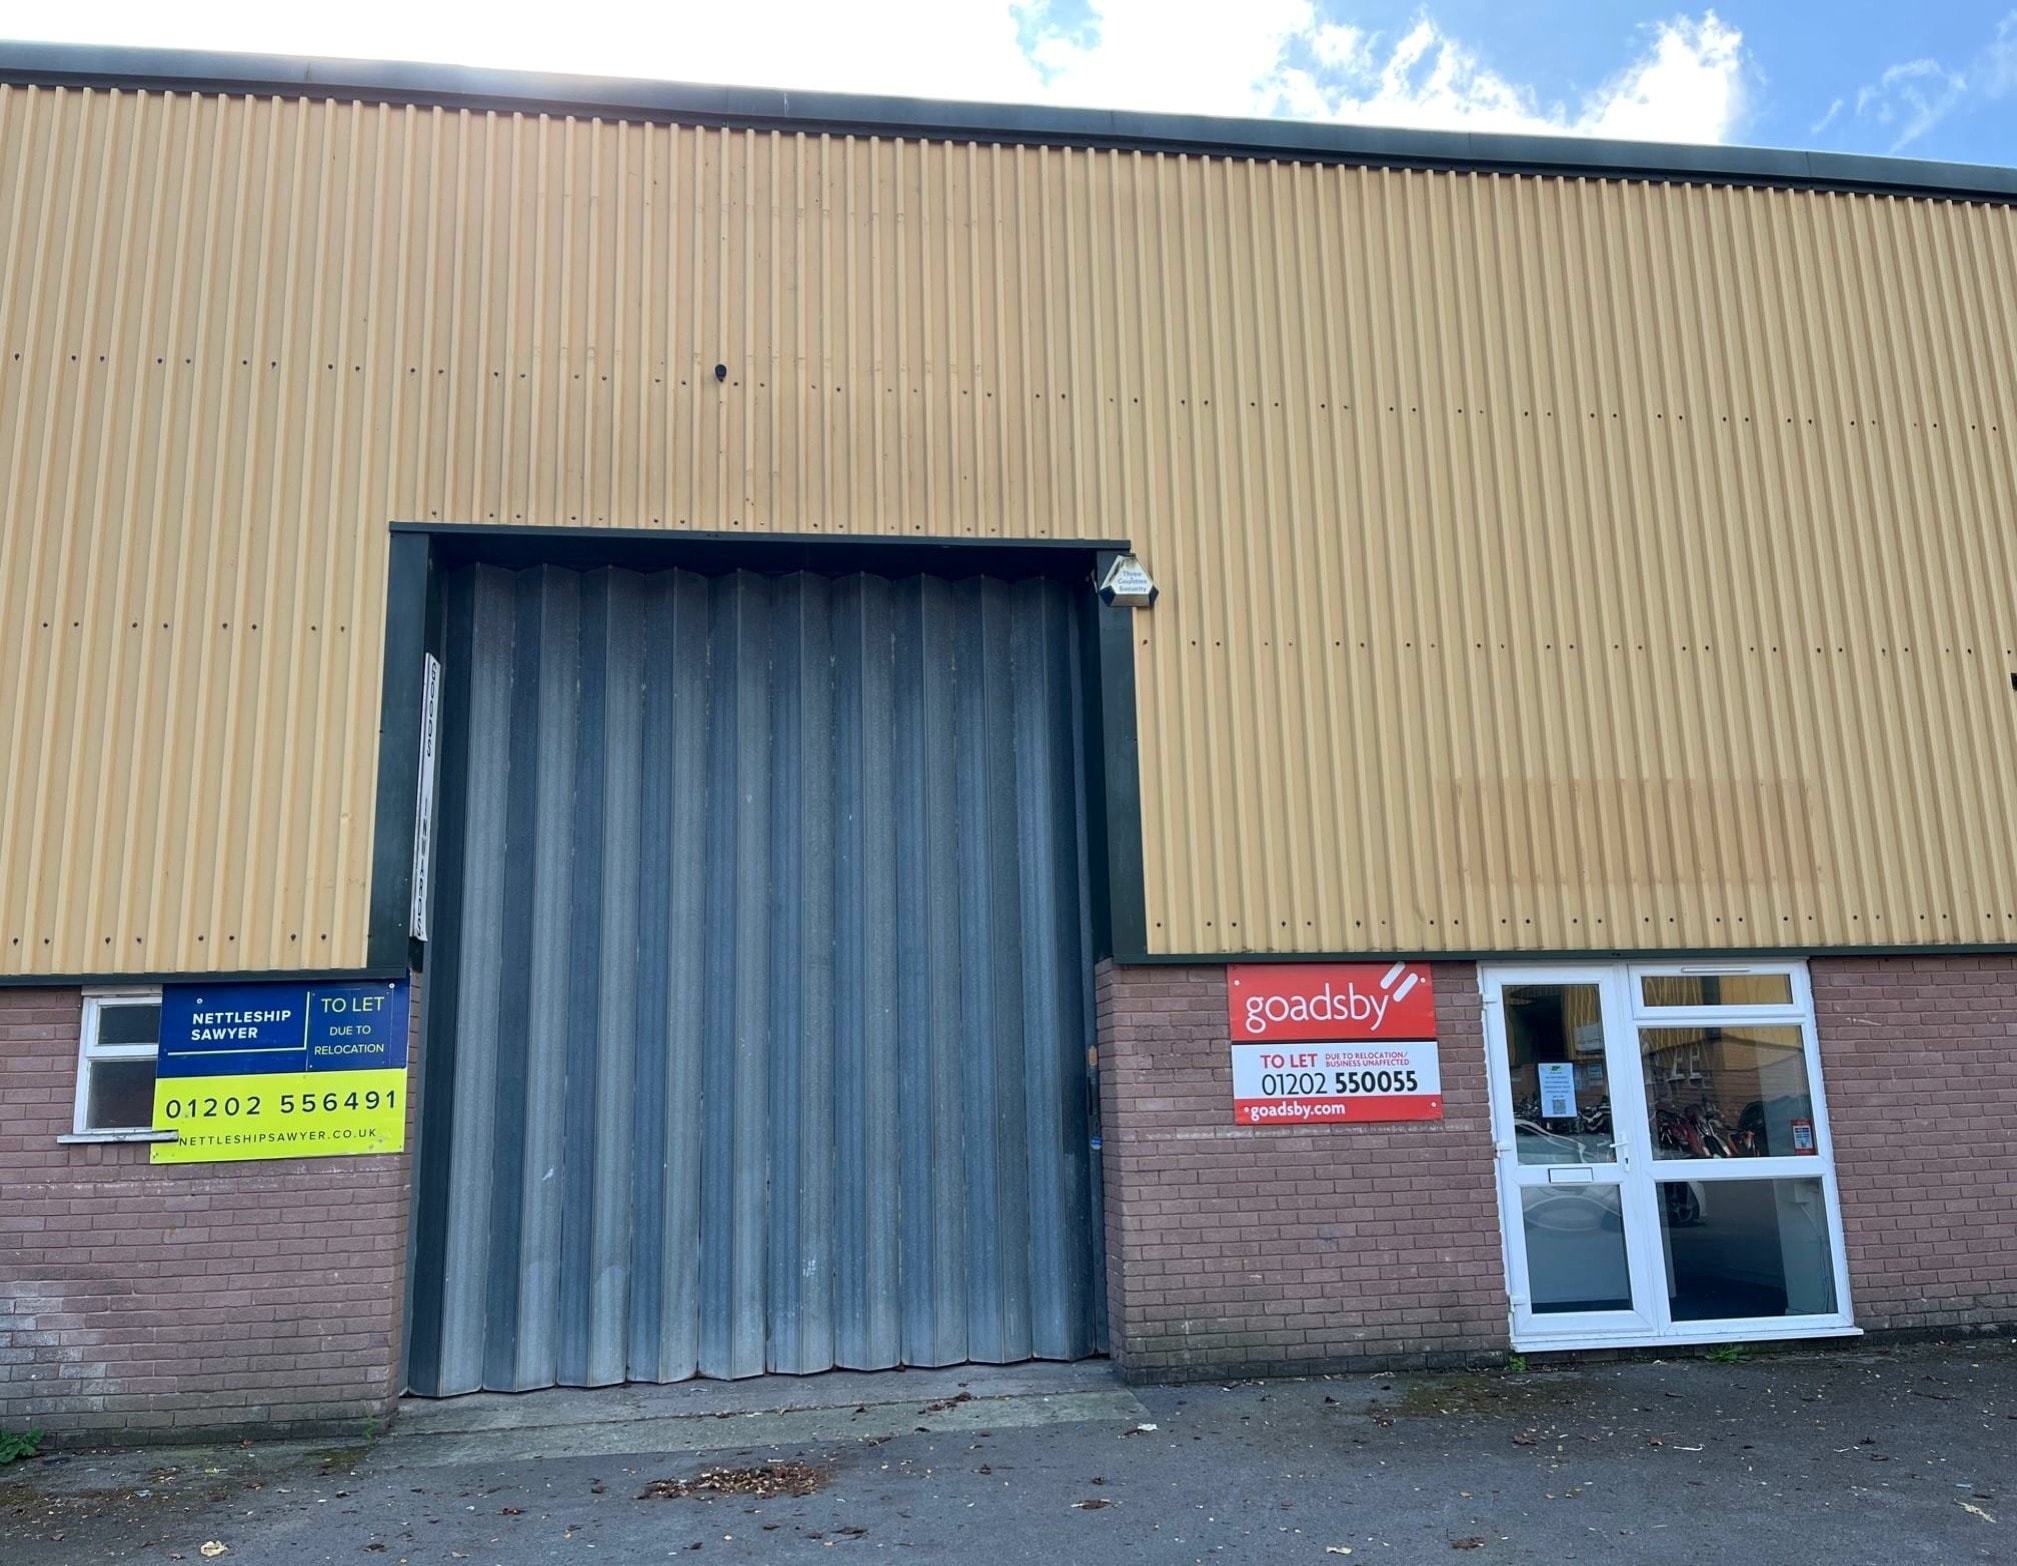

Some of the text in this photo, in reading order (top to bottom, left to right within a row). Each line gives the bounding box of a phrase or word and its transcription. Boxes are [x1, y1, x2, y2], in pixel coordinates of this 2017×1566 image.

[321, 996, 385, 1013] TO LET
[1245, 982, 1389, 1034] goadsby
[193, 1010, 291, 1025] NETTLESHIP
[191, 1027, 258, 1041] SAWYER
[329, 1025, 371, 1036] DUE TO
[314, 1043, 384, 1056] RELOCATION
[1342, 1052, 1354, 1060] TO
[1355, 1051, 1409, 1060] RELOCATION/
[1260, 1053, 1318, 1069] TO LET
[1326, 1058, 1410, 1068] BUSINESS UNAFFECTED
[1261, 1070, 1418, 1096] 01202 550055
[166, 1090, 396, 1119] 01202 556491
[1251, 1101, 1346, 1121] goadsby.com
[179, 1128, 377, 1147] NETTLESHIPSAWYER.CO.UK
